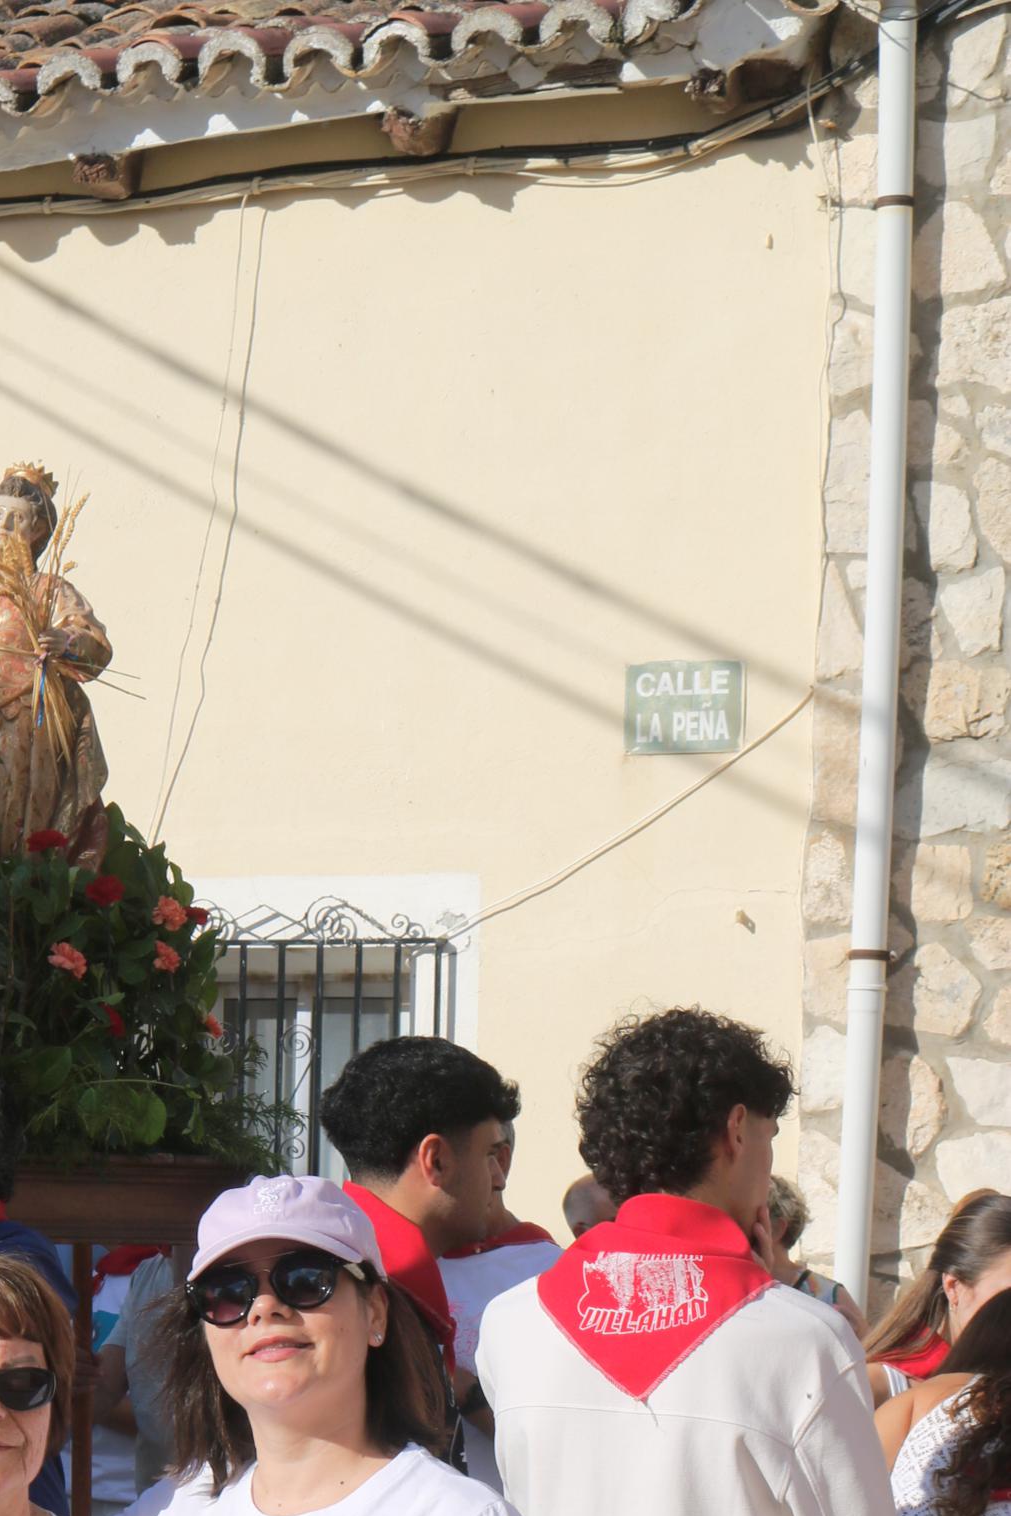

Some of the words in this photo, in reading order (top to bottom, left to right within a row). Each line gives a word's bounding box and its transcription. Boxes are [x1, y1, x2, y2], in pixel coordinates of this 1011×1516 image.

[637, 670, 730, 697] CALLE
[636, 713, 662, 743] LA
[673, 701, 730, 742] PEÑA
